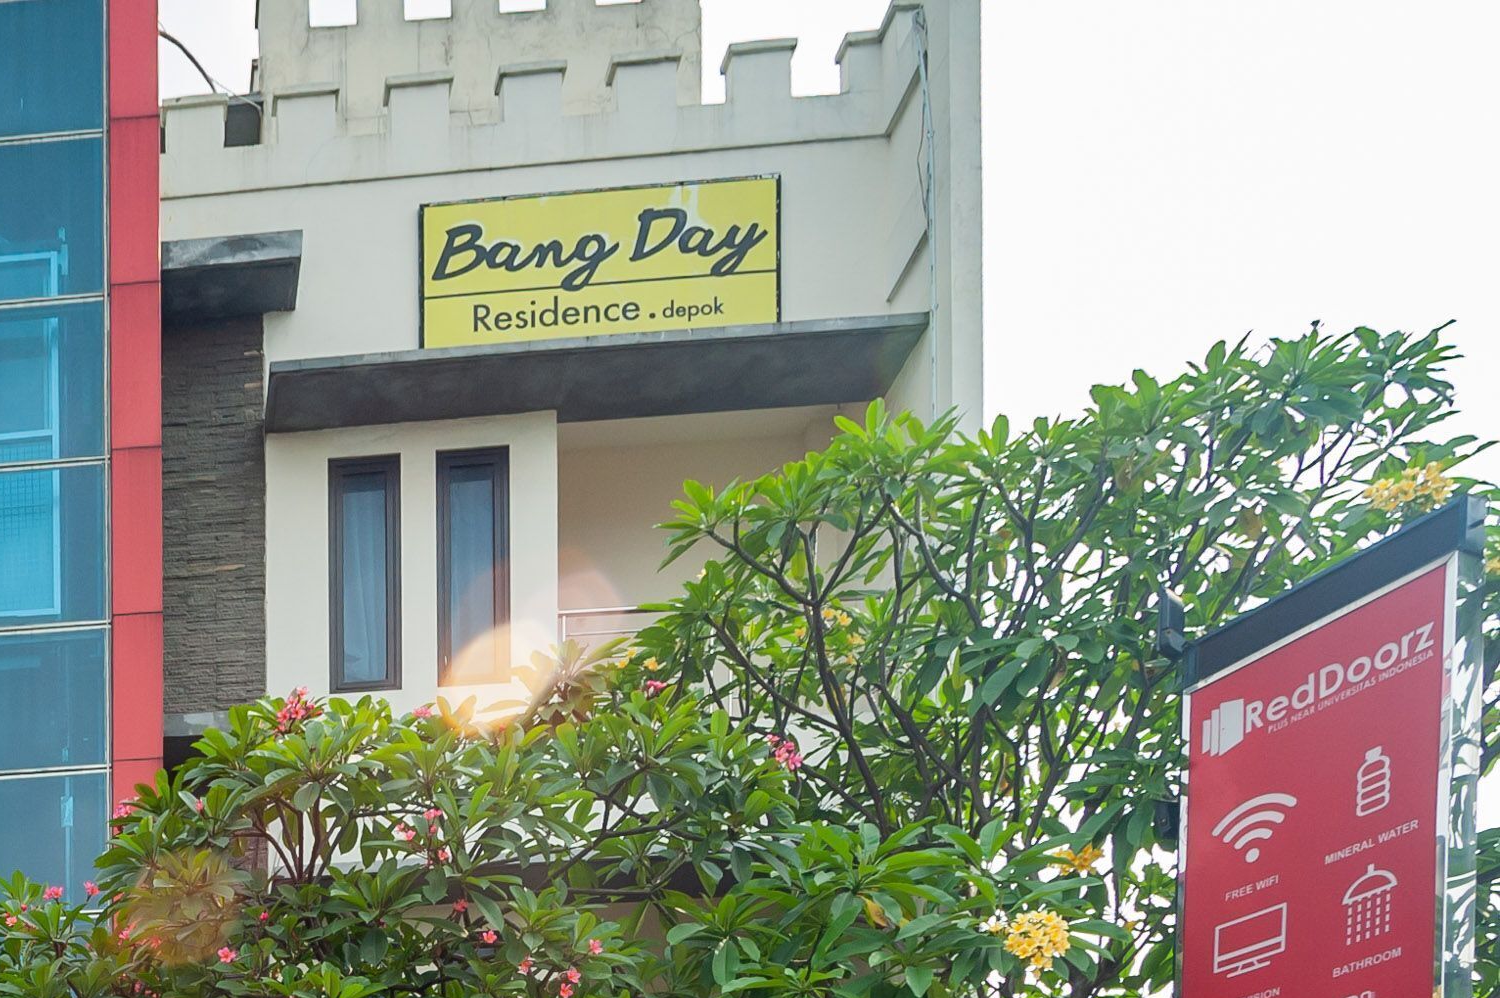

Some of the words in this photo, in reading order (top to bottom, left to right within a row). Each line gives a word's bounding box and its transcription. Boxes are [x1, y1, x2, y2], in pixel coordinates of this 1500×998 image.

[431, 223, 620, 291] Bang
[629, 208, 768, 276] Day
[662, 296, 724, 322] depok
[1245, 621, 1434, 734] RedDoorz
[1267, 716, 1289, 734] PLUS
[1290, 707, 1315, 724] NEAR
[1317, 677, 1376, 711] UNIVERSITAS
[1378, 650, 1434, 682] INDONESIA
[1324, 839, 1375, 865] MINERAL
[1377, 818, 1419, 846] WATER
[1225, 884, 1254, 901] FREE
[1256, 875, 1280, 893] WIFI
[1332, 947, 1402, 978] BATHROOM
